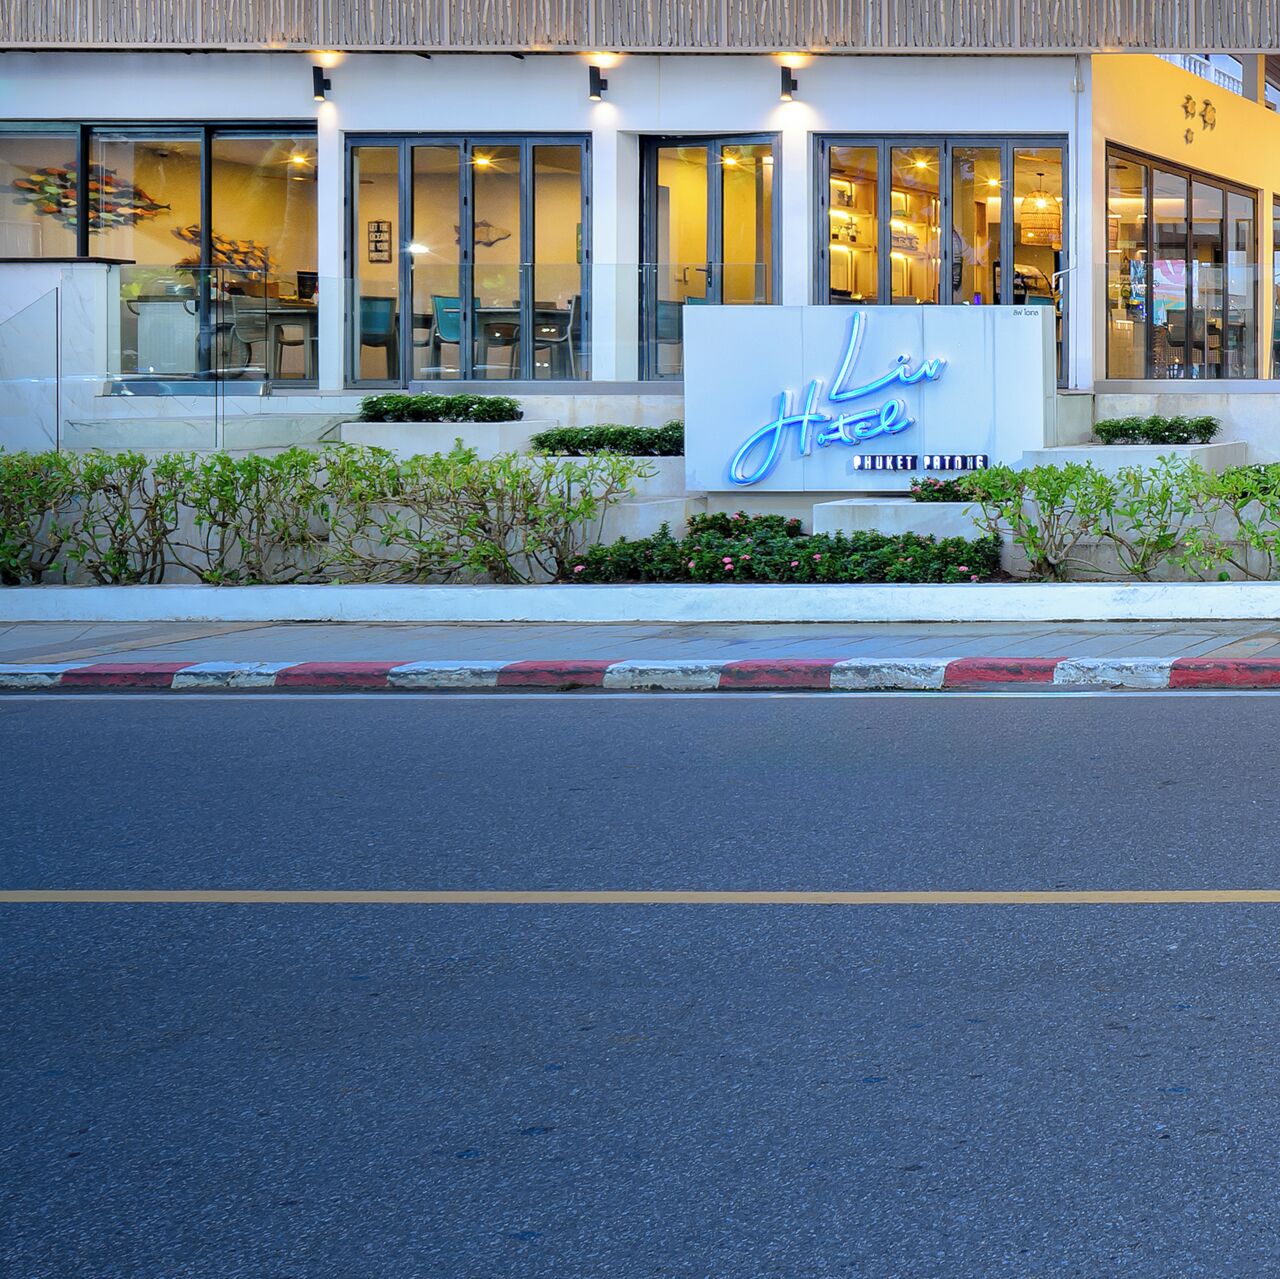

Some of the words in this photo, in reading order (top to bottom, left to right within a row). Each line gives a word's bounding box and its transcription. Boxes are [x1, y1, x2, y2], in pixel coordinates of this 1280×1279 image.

[829, 311, 947, 402] Liv
[728, 380, 916, 487] Hotel
[853, 454, 916, 470] PHUKET
[923, 454, 987, 470] PATONG
